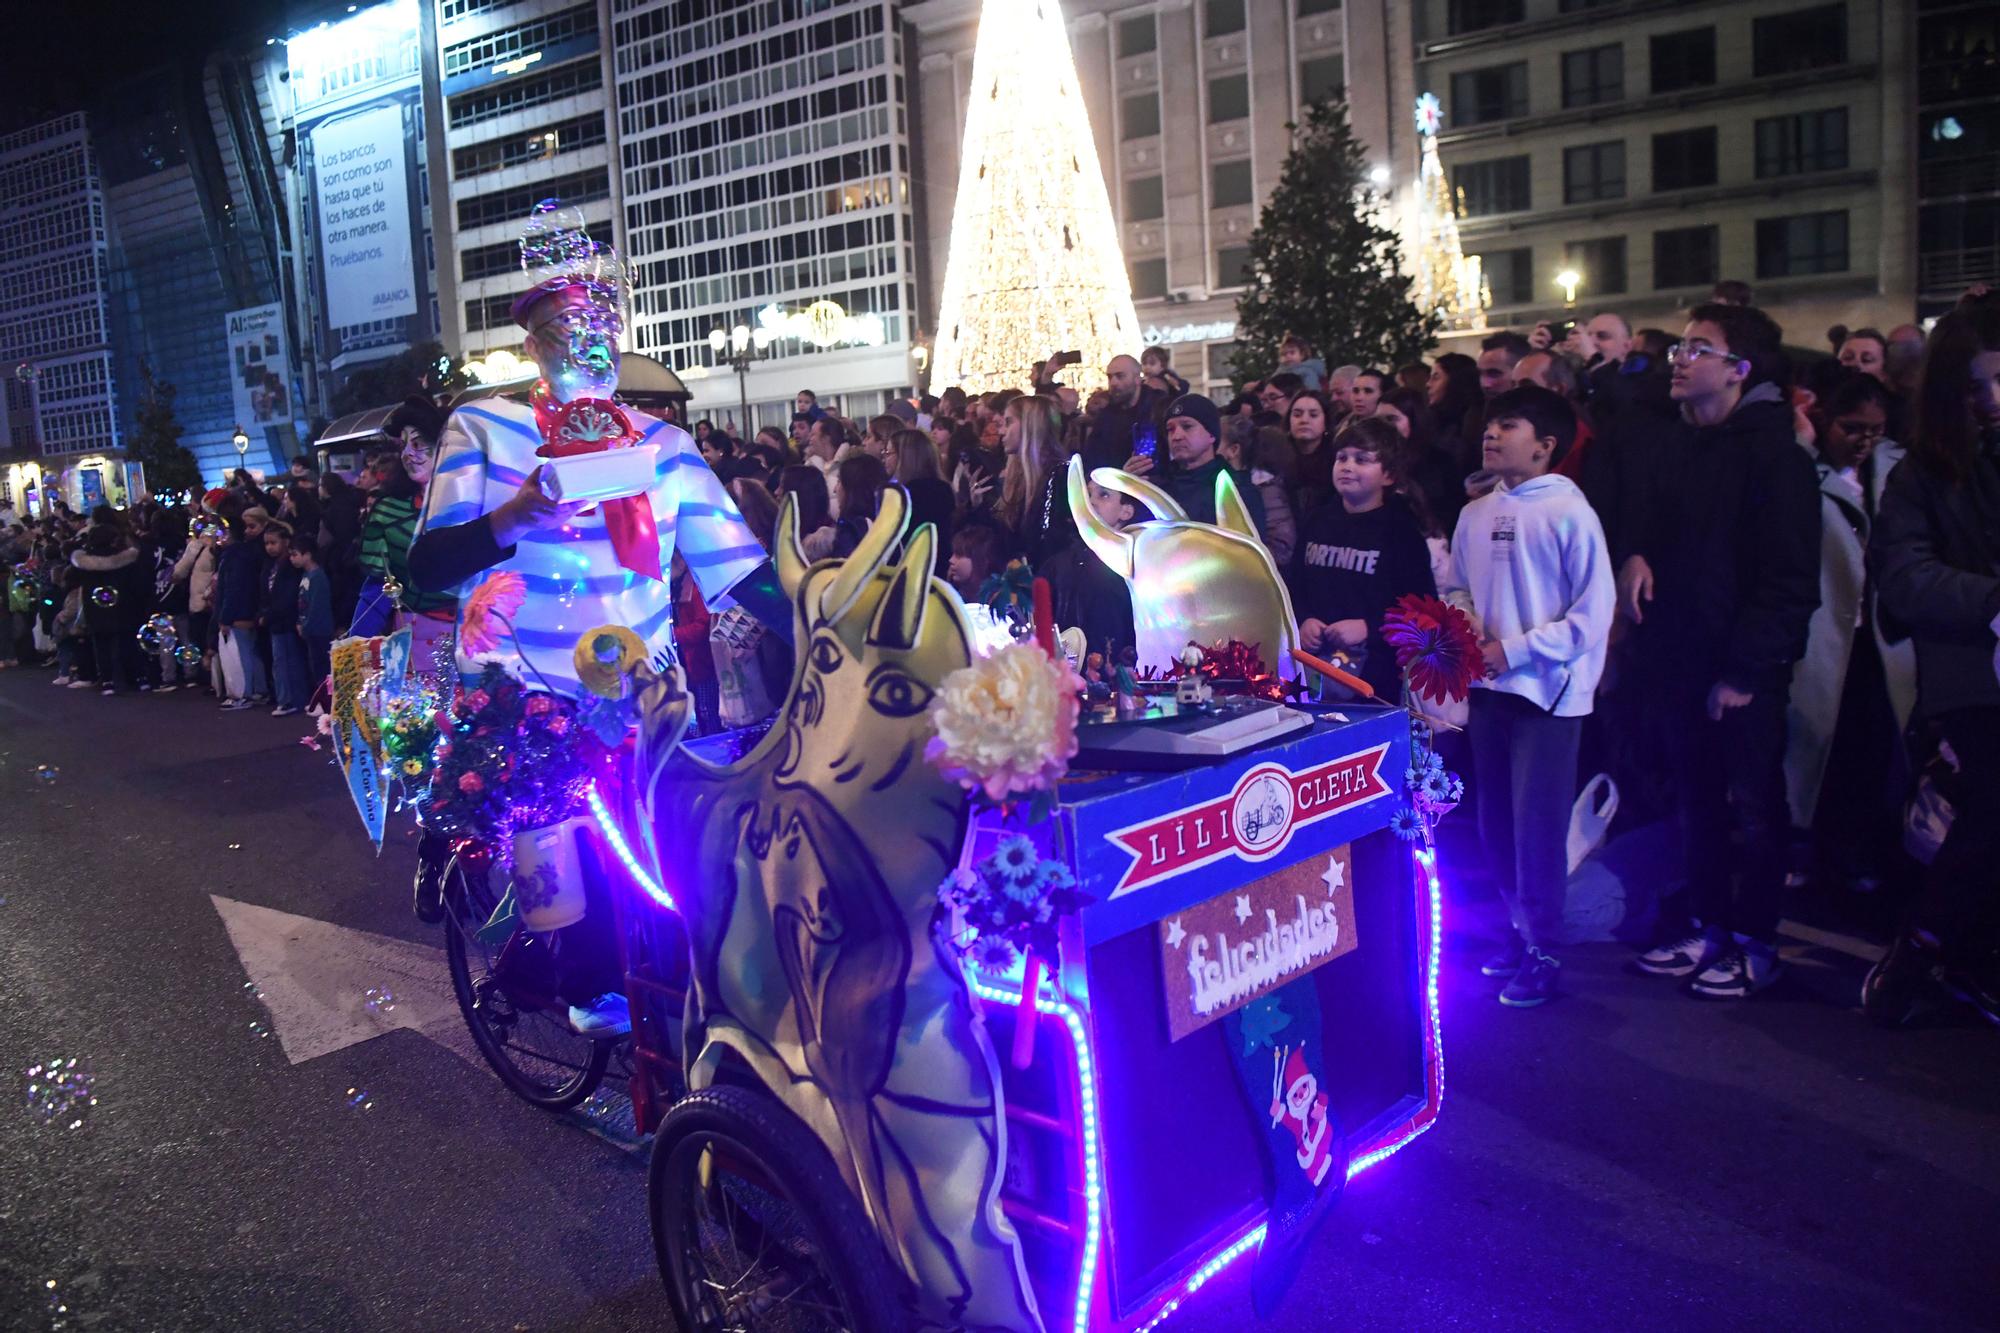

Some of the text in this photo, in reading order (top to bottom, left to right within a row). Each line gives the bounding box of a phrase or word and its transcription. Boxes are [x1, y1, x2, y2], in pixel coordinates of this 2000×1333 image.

[321, 143, 376, 168] Los bancos
[323, 158, 392, 187] son como son
[325, 178, 384, 205] hasta que tú
[326, 199, 385, 225] los haces de
[328, 220, 389, 244] otra manera.
[330, 246, 384, 268] Pruébanos.
[372, 288, 409, 306] ABANCA
[1305, 541, 1380, 575] FORTNITE
[1298, 763, 1368, 810] CLETA
[1188, 894, 1339, 1016] felicidades
